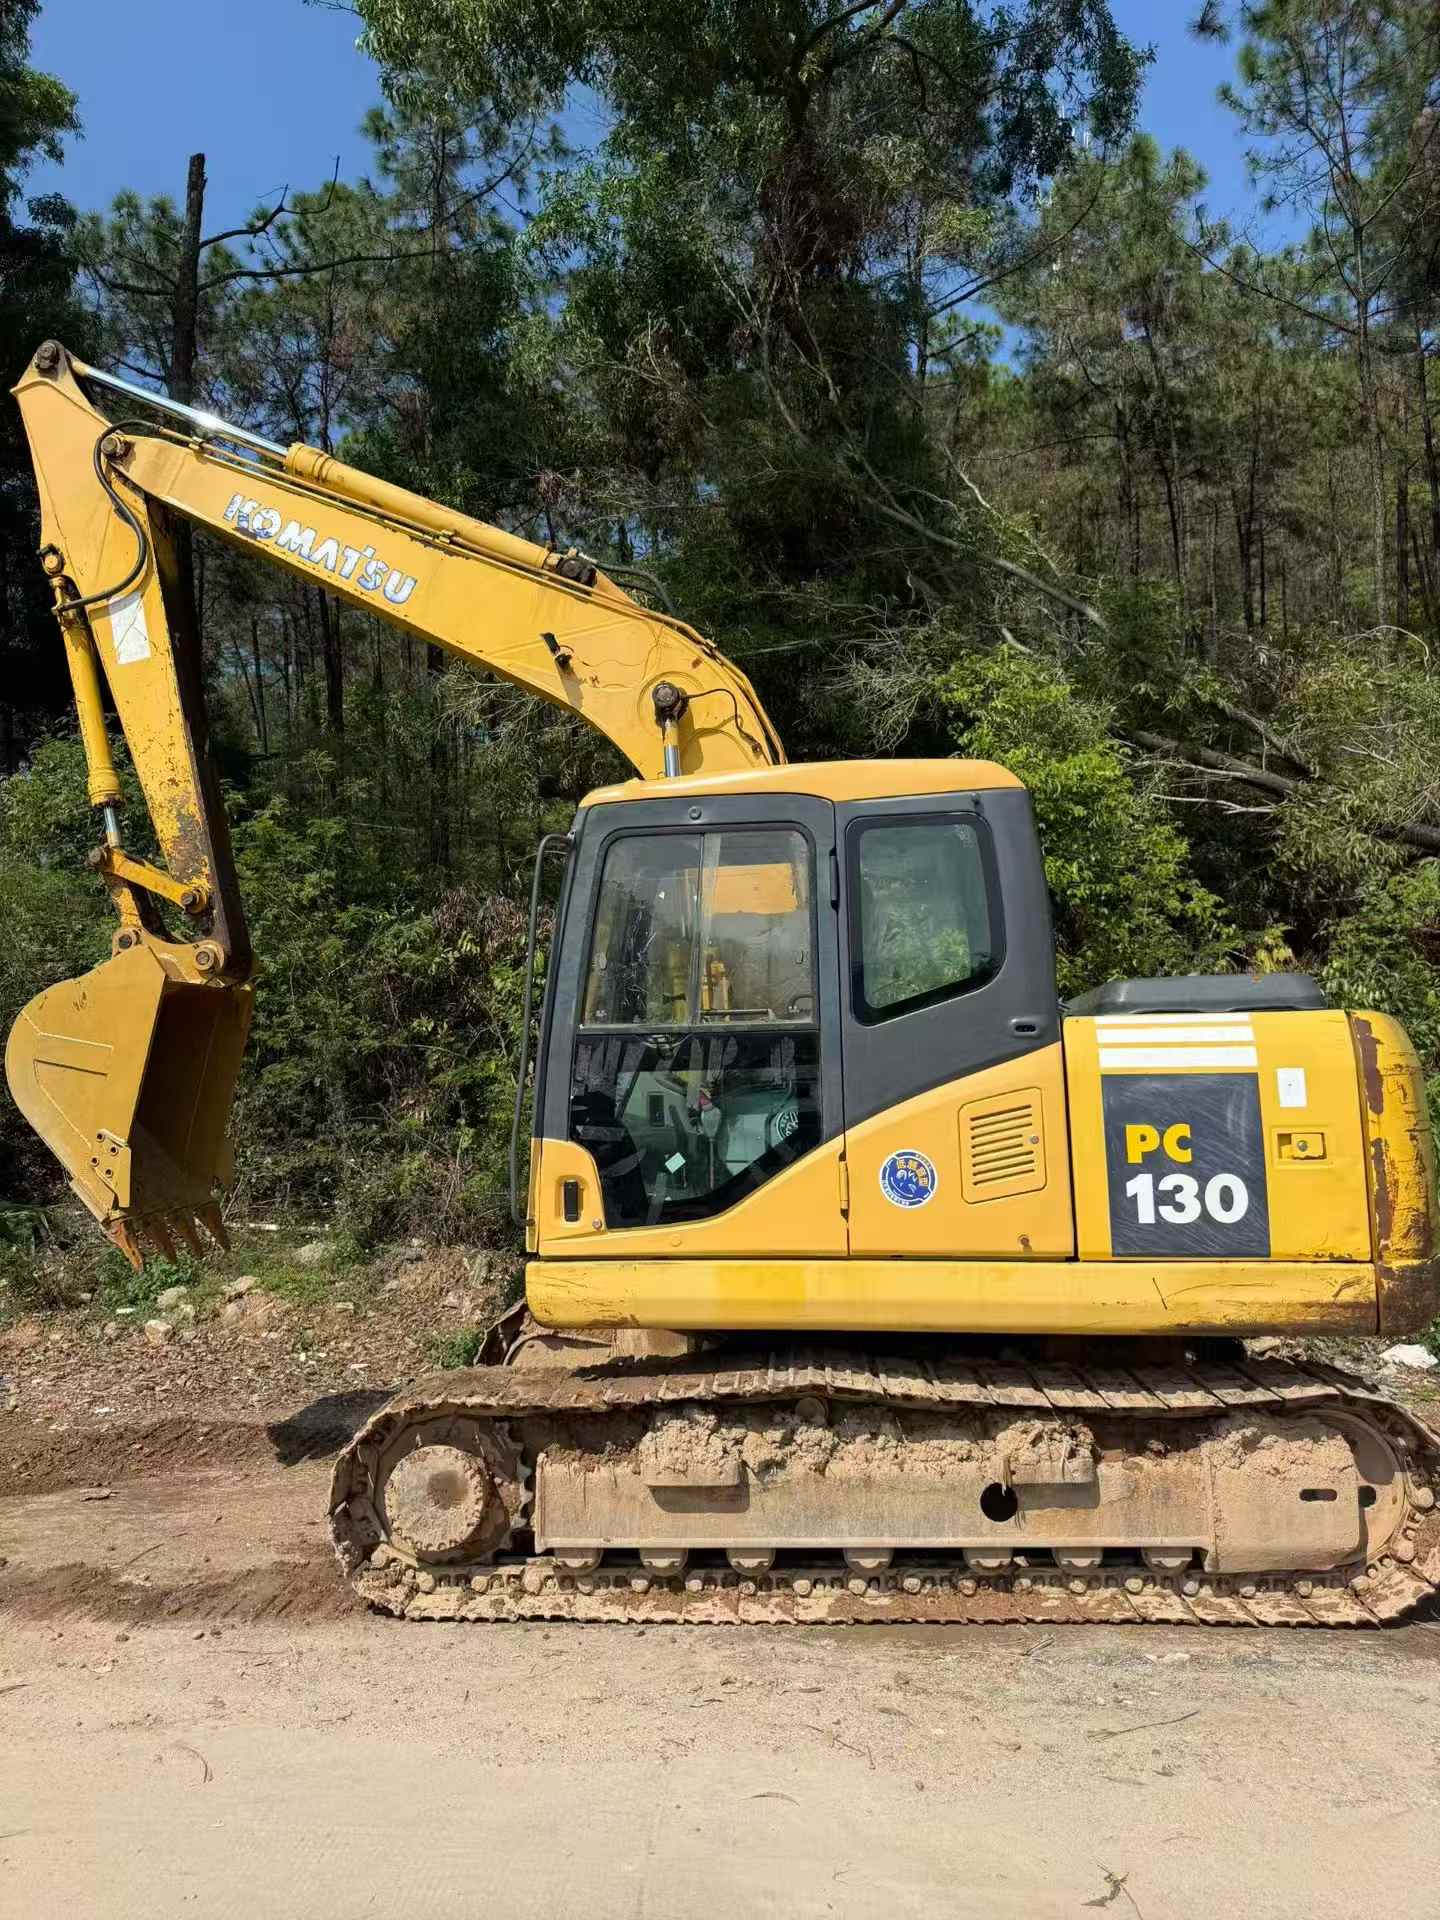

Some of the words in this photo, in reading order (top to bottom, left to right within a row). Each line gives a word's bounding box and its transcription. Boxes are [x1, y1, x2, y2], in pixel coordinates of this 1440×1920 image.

[223, 493, 418, 604] KOMATSU
[1125, 1123, 1192, 1164] PC
[1126, 1173, 1249, 1224] 130
